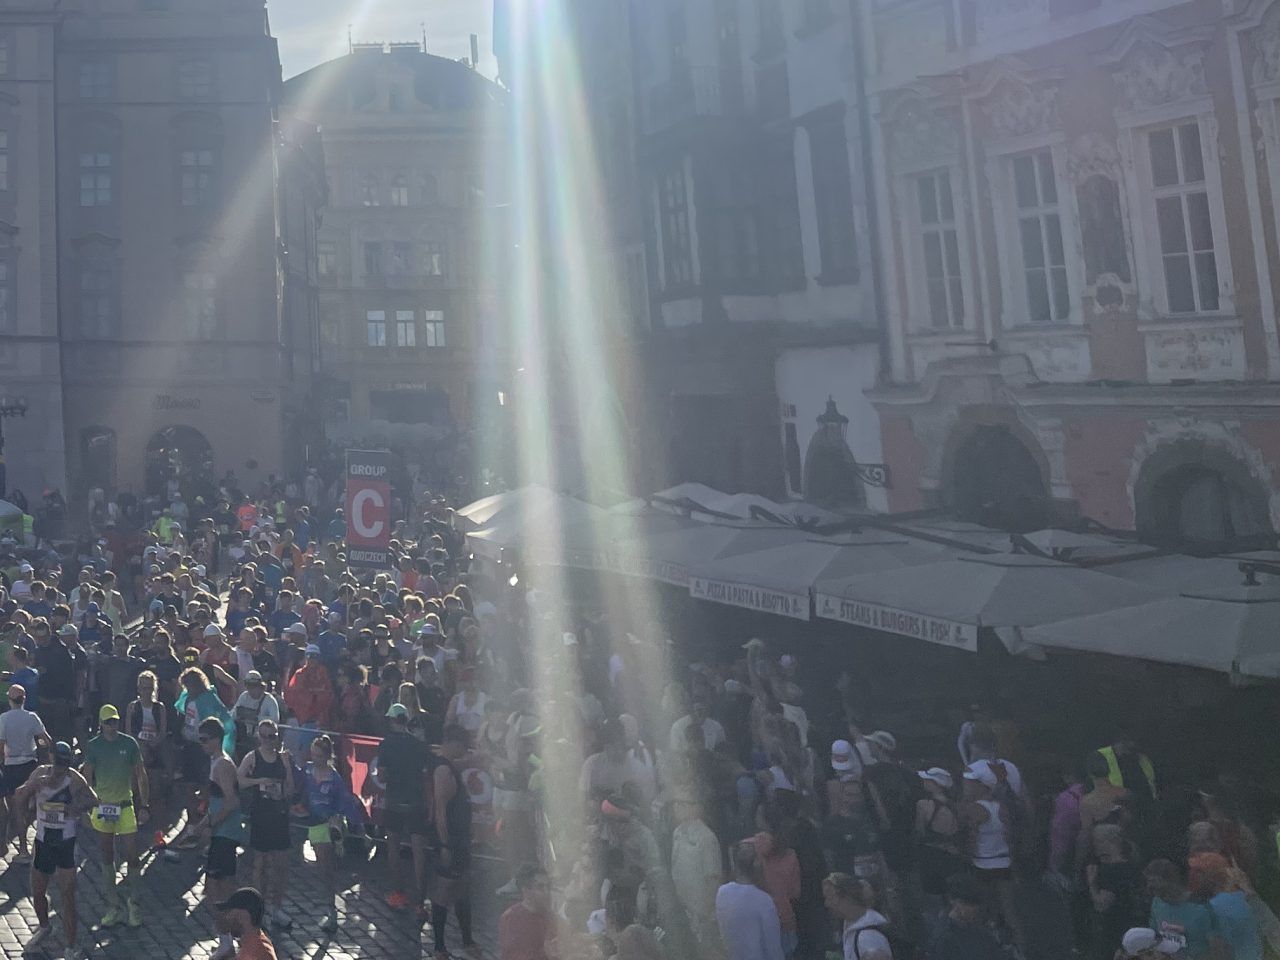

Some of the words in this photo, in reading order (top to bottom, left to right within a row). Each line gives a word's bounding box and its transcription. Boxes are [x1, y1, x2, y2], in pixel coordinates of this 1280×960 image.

[350, 464, 387, 477] GROUP
[352, 488, 385, 538] C
[733, 587, 754, 605] PASTA
[762, 592, 792, 614] RISOTTO
[839, 601, 872, 625] STEAKS
[881, 611, 921, 637] BURGERS
[930, 620, 951, 640] FISH
